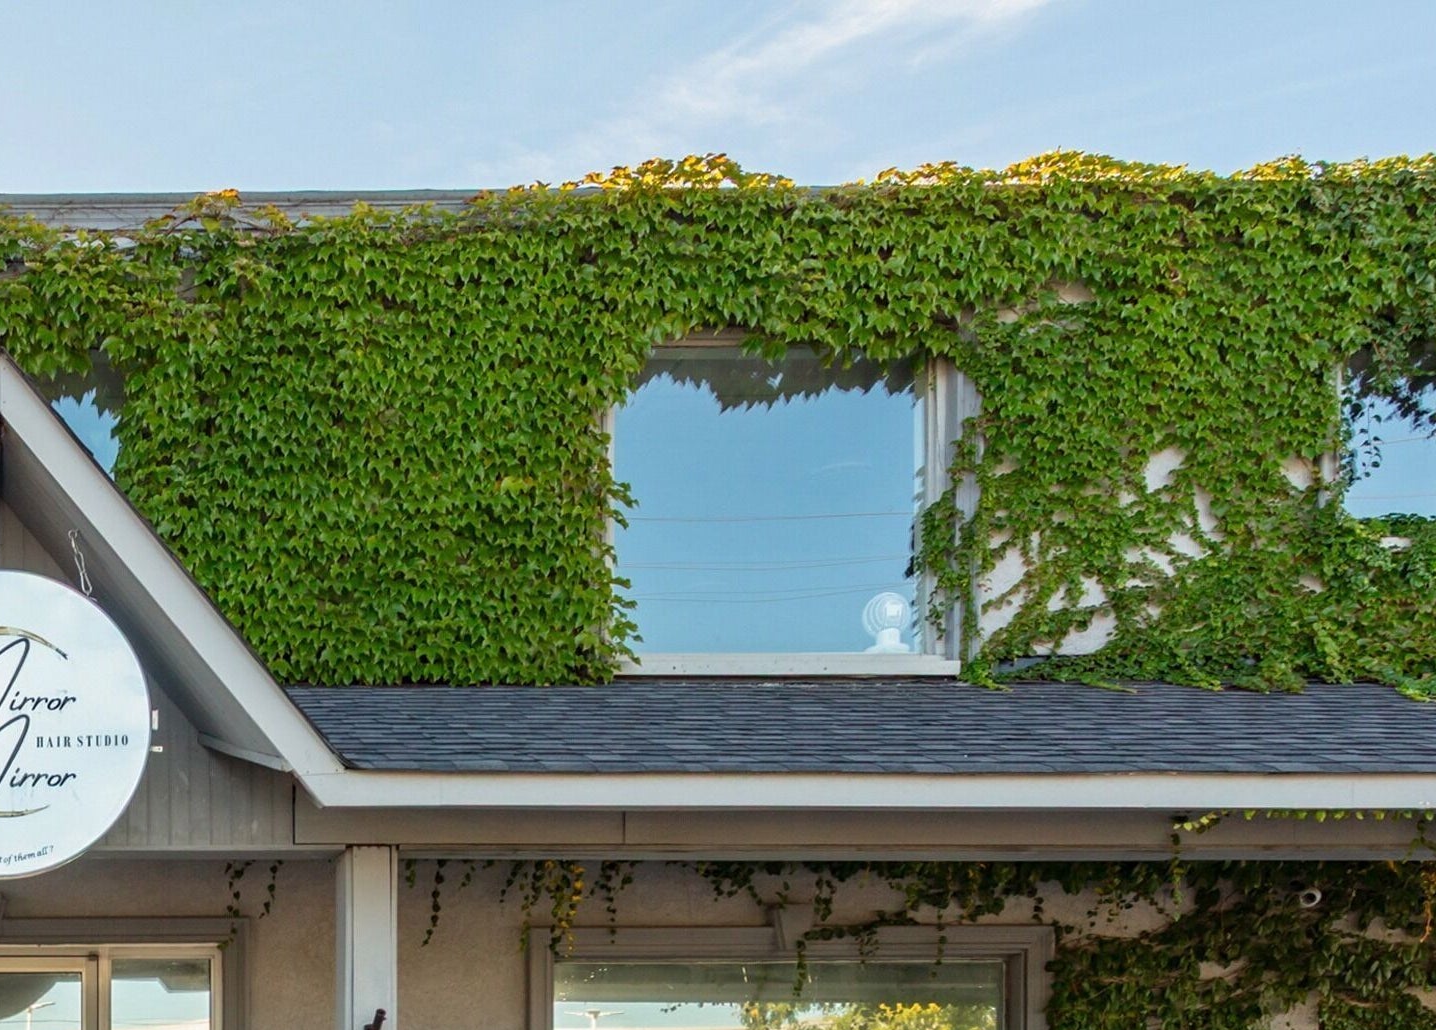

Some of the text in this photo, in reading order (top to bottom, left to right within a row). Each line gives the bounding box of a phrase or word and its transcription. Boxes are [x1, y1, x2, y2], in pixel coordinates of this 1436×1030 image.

[36, 734, 129, 748] HAIR STUDIO
[3, 854, 14, 865] of
[14, 851, 36, 863] them
